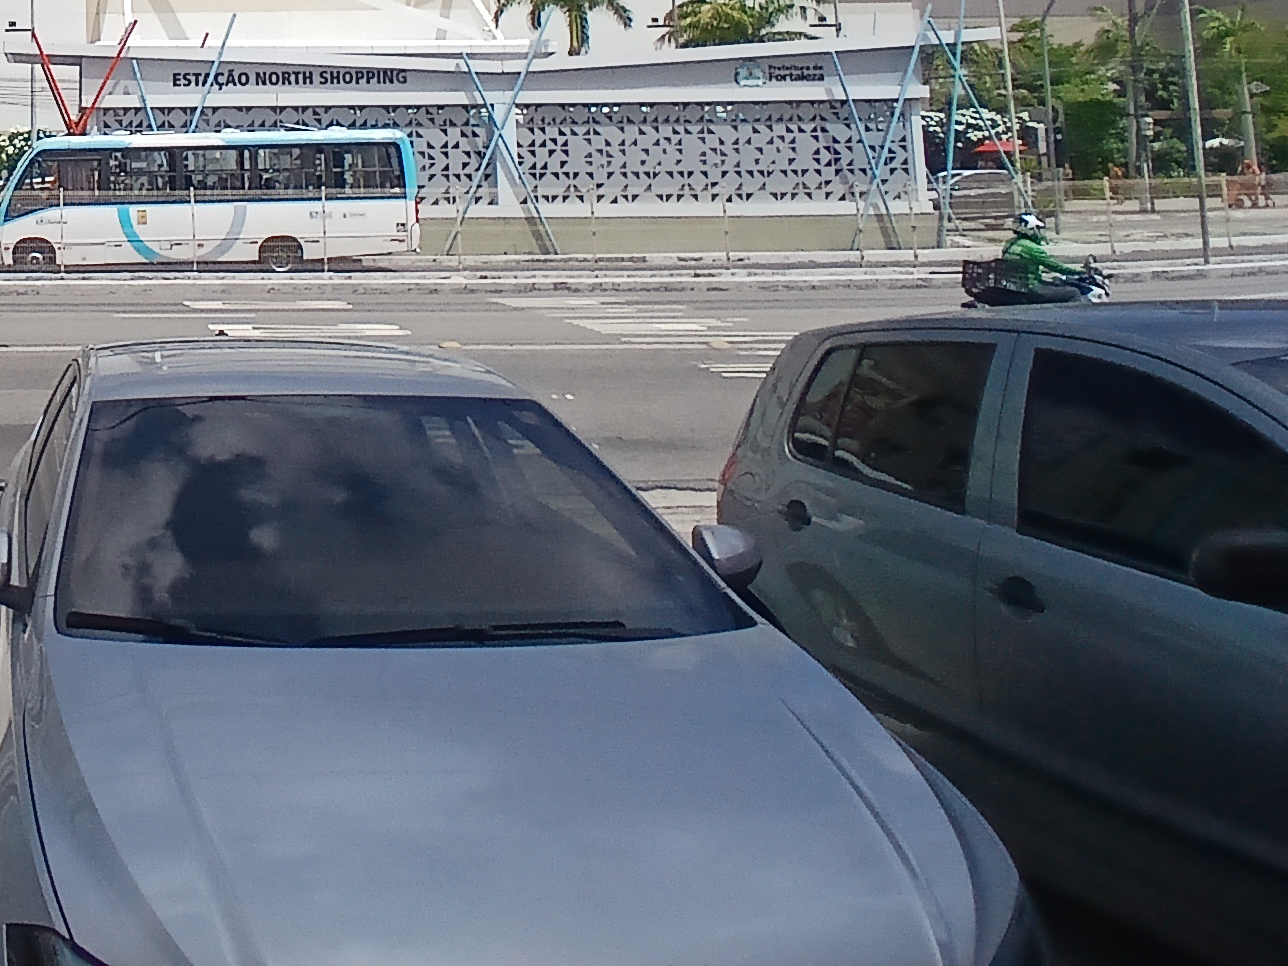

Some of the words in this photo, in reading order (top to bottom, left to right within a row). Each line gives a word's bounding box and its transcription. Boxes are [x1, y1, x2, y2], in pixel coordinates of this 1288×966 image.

[768, 64, 810, 72] Prefeitura
[172, 69, 250, 90] ESTAÇÃO
[255, 71, 314, 86] NORTH
[319, 69, 408, 86] SHOPPING
[768, 71, 825, 82] Fortaleza
